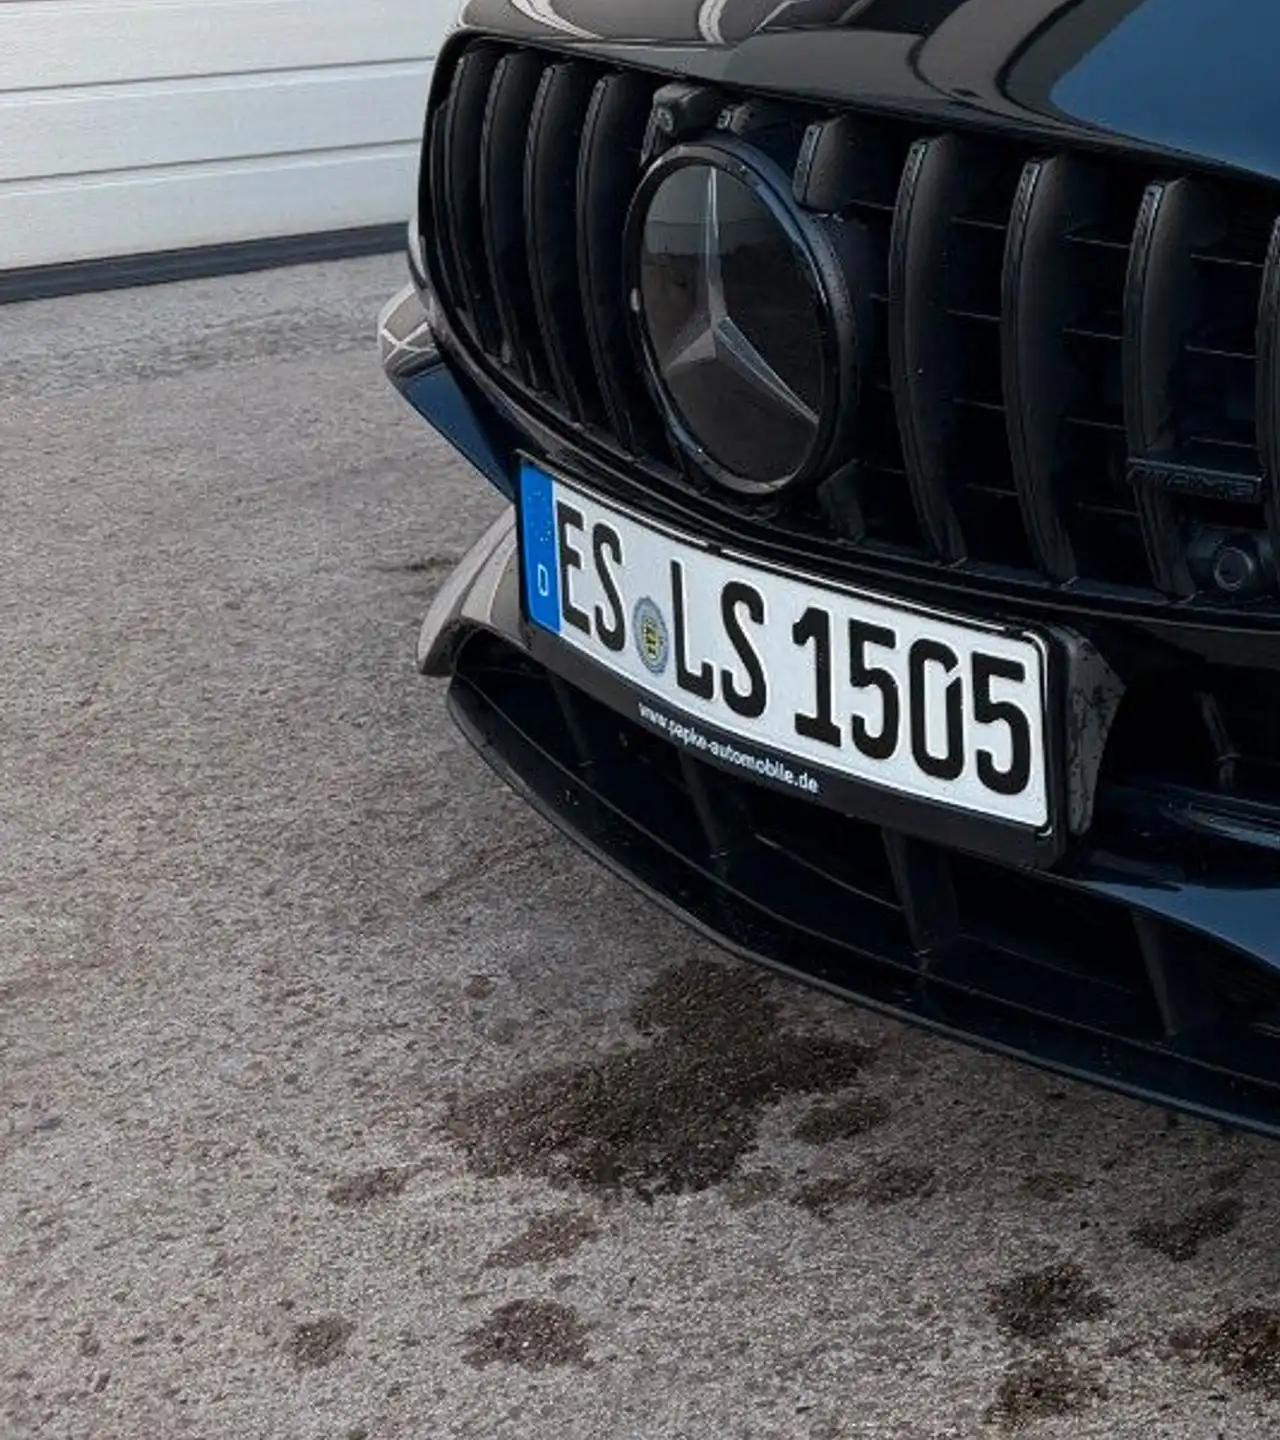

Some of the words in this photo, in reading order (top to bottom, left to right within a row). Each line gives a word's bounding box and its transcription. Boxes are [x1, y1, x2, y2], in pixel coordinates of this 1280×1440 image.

[555, 502, 626, 652] ES
[671, 559, 767, 719] LS
[792, 607, 1031, 795] 1505
